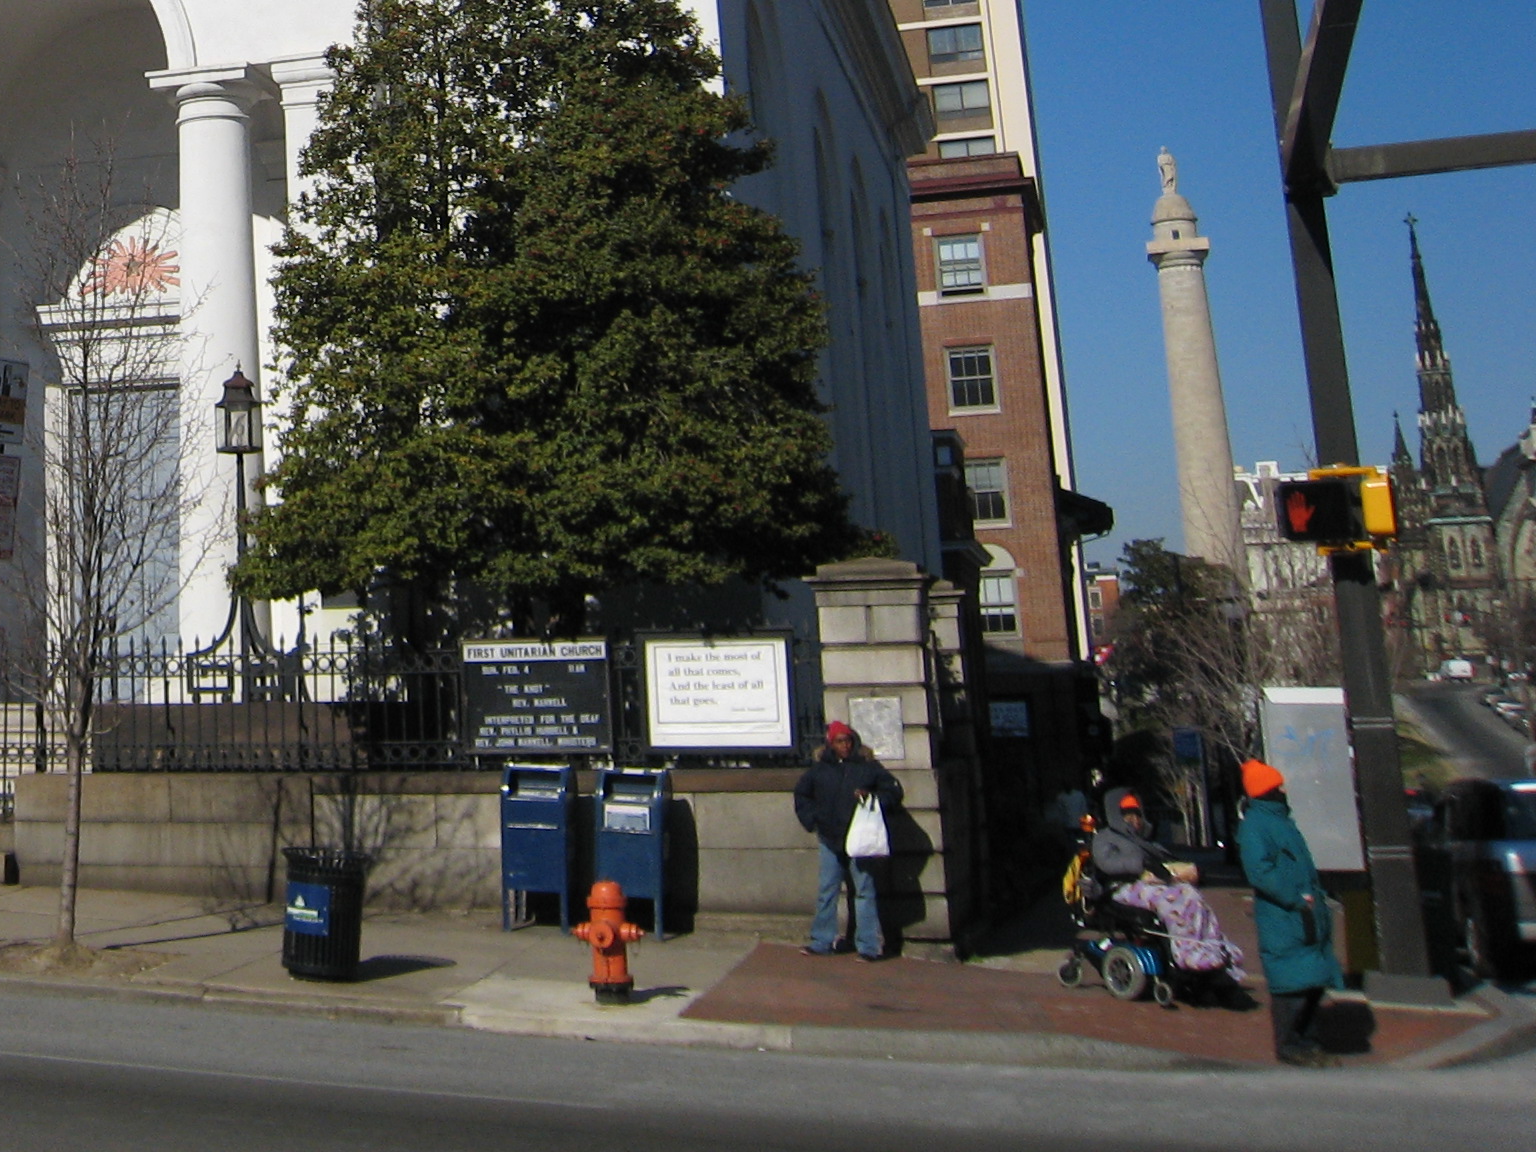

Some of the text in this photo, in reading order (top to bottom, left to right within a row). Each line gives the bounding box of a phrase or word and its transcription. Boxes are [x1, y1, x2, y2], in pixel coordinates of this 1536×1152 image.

[467, 645, 602, 659] FIRST UNITARIAN CHURCH
[675, 652, 702, 663] make
[705, 652, 720, 661] the
[724, 651, 748, 661] most
[751, 650, 762, 660] of
[668, 668, 681, 677] all
[683, 667, 704, 677] that
[669, 679, 764, 691] And the least of all
[669, 696, 690, 705] that
[540, 714, 556, 725] FOR
[560, 714, 575, 724] THE
[579, 713, 600, 724] DEAF
